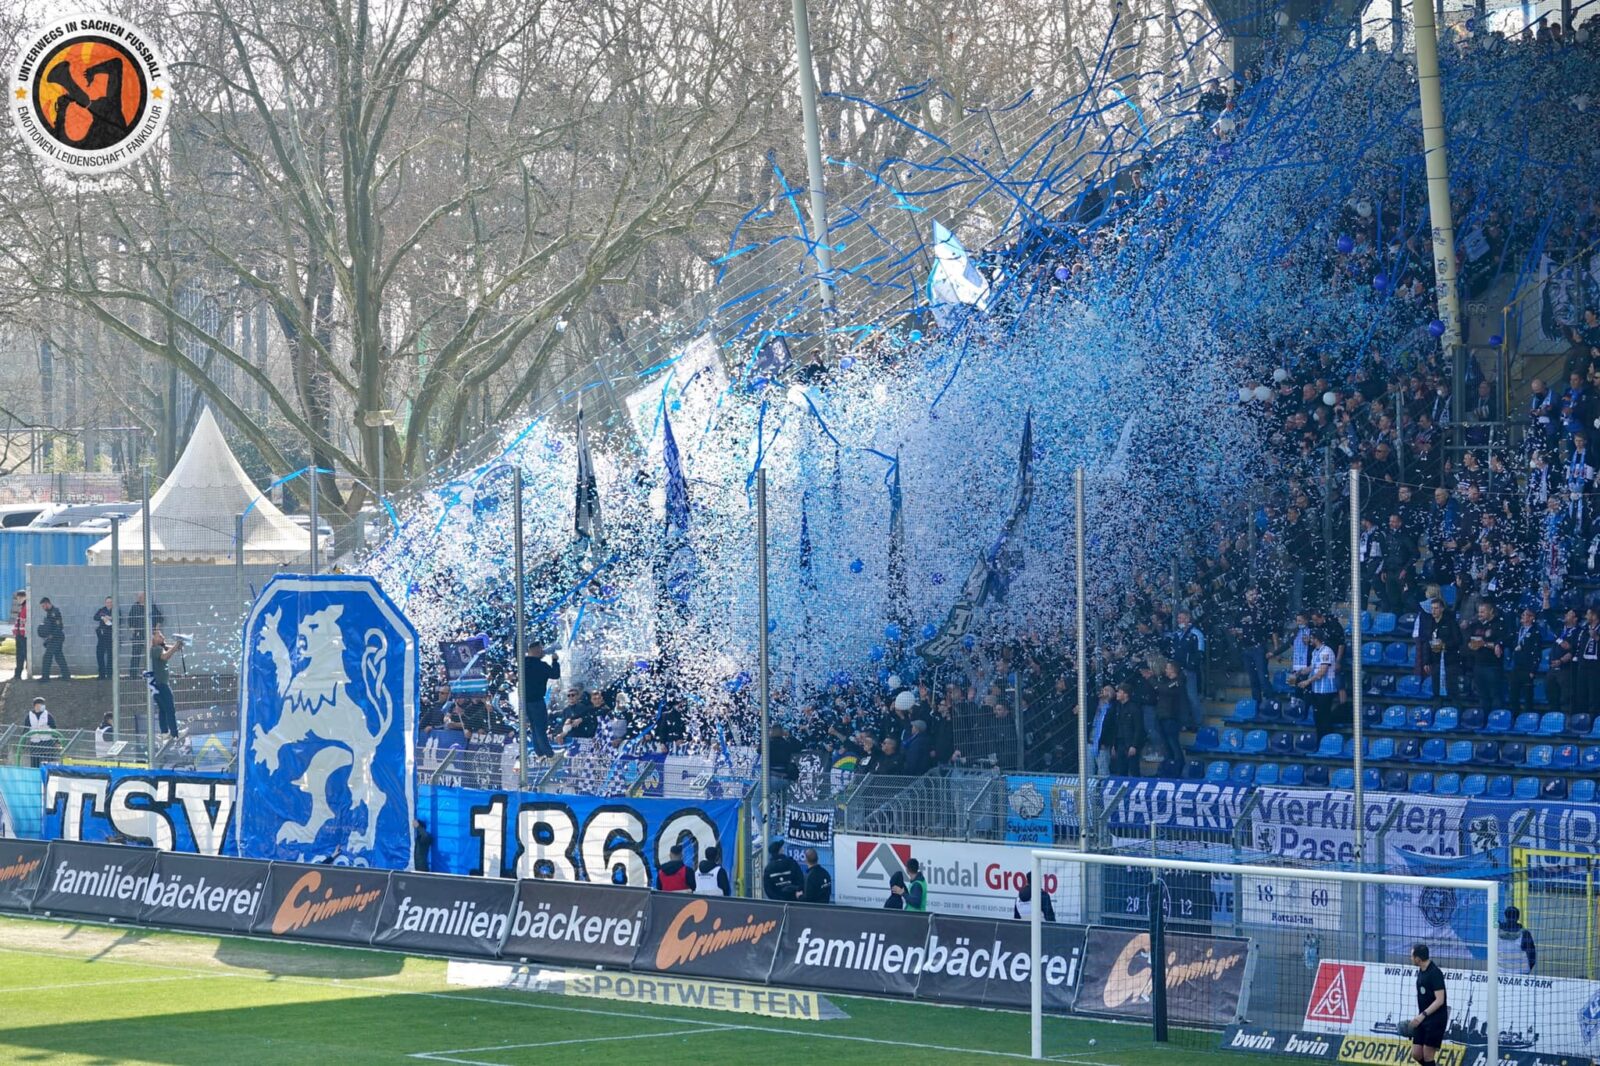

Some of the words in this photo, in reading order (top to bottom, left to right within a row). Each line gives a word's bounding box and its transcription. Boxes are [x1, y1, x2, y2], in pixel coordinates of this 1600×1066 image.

[46, 773, 236, 855] TSV
[790, 810, 829, 824] WAMBO
[1257, 790, 1447, 834] Vierkichen
[470, 794, 722, 887] 1860
[788, 849, 808, 861] 186
[985, 863, 1058, 894] Grop
[1257, 884, 1274, 903] 18
[1311, 888, 1329, 907] 60
[271, 870, 381, 934] Grimminger
[655, 899, 777, 970] Grimminger
[1103, 932, 1240, 1008] Gimminger
[1384, 967, 1401, 976] WIR
[1402, 968, 1413, 977] IN
[1469, 973, 1522, 986] GEMNSAM
[1523, 978, 1553, 989] STARK
[573, 975, 811, 1017] SPORTWETTEN
[1231, 1029, 1275, 1049] bwin
[1284, 1034, 1330, 1056] bwin
